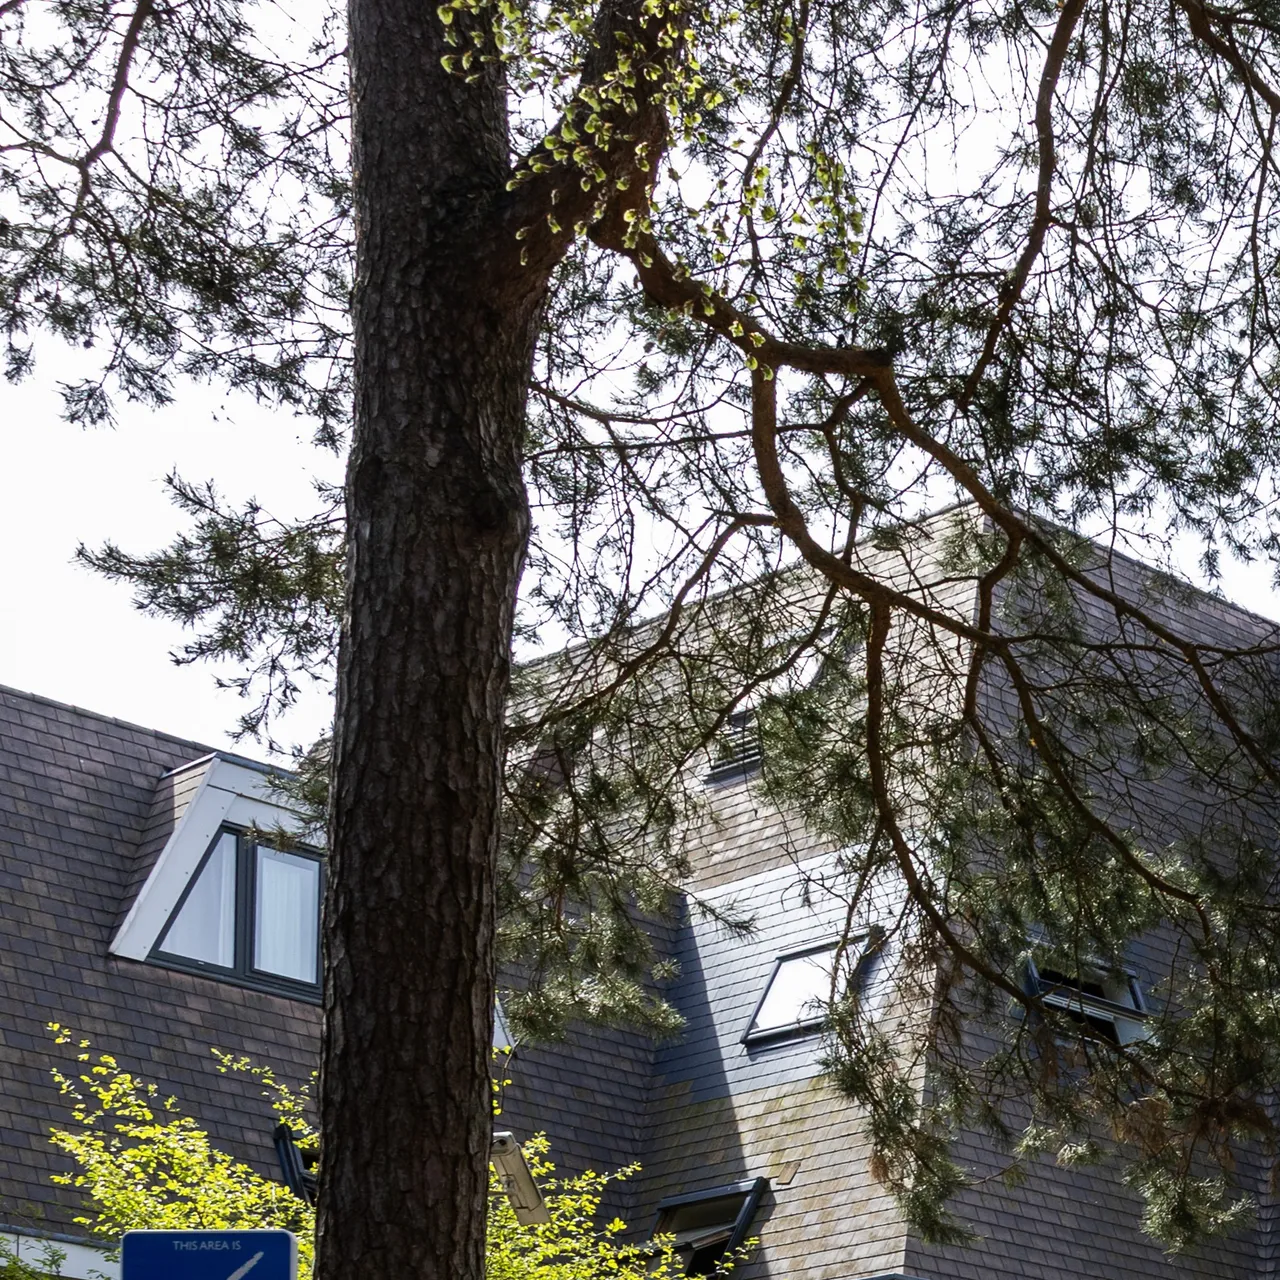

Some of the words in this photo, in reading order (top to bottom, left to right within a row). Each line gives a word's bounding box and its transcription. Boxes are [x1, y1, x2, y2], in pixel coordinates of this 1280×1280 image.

[172, 1240, 198, 1250] THIS
[199, 1240, 230, 1250] AREA
[232, 1240, 242, 1250] IS
